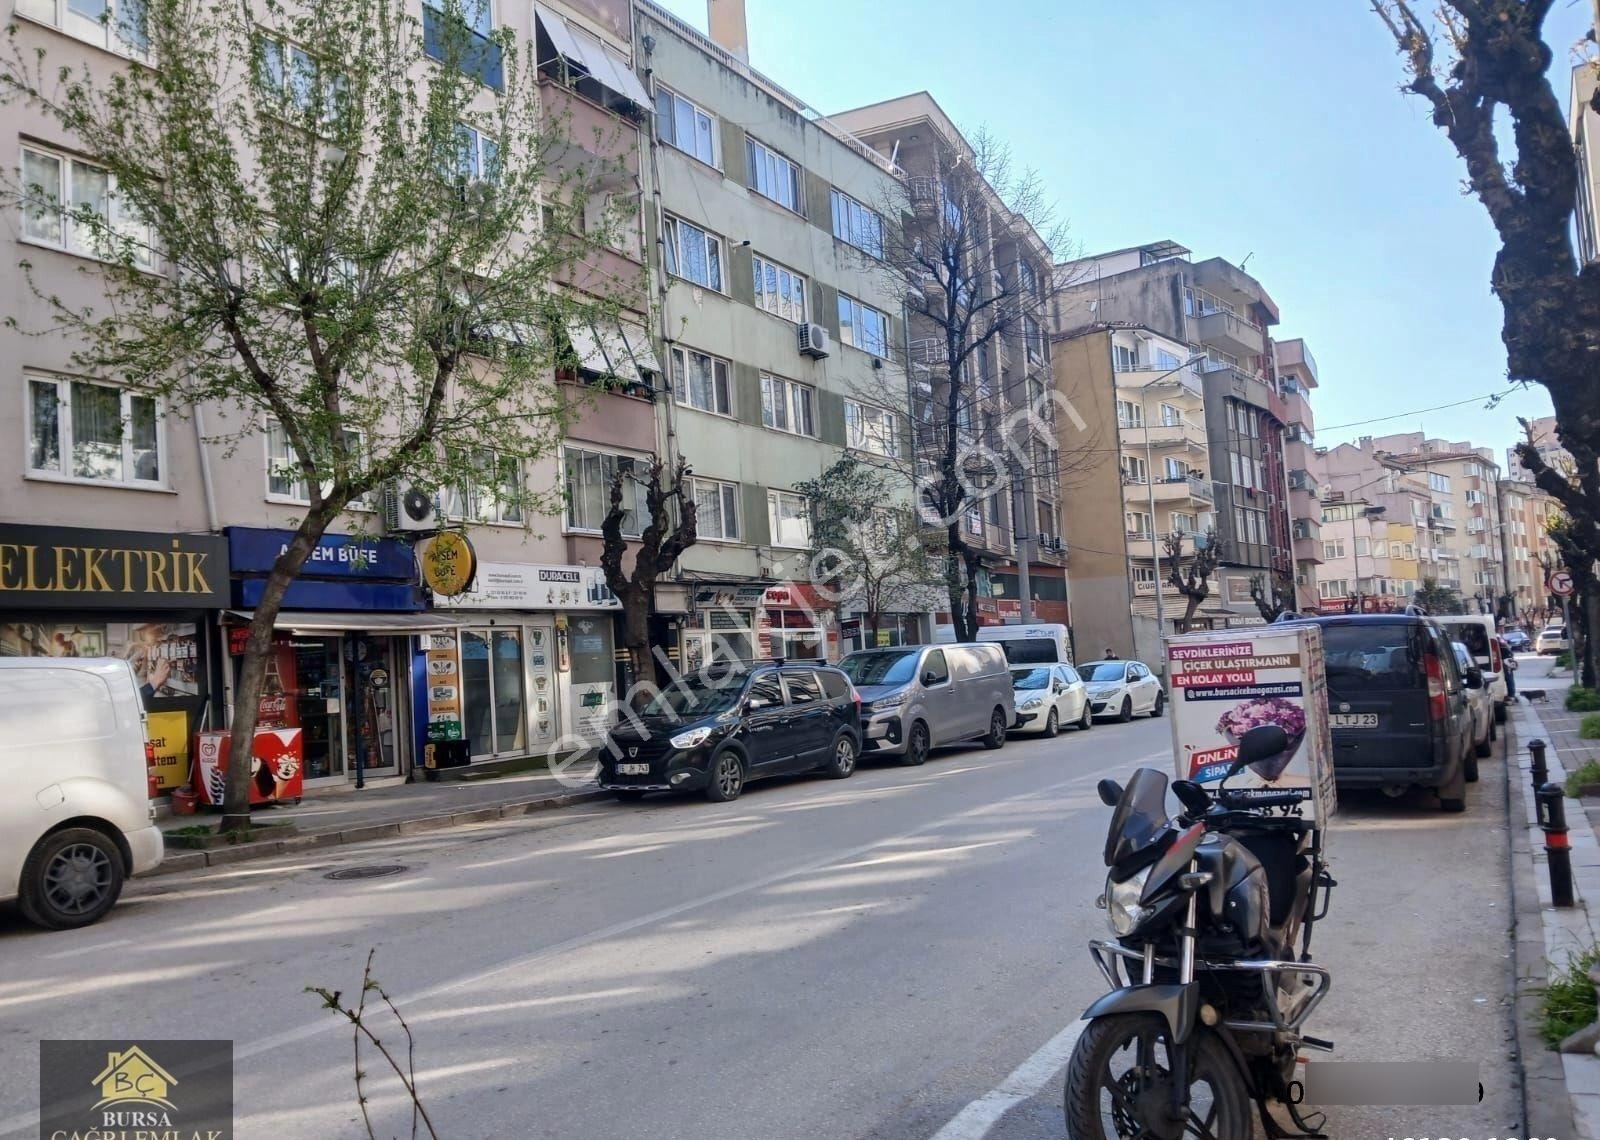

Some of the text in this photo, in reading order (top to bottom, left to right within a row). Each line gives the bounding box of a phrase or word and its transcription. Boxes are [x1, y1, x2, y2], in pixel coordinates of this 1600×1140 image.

[0, 538, 214, 594] ELEKTRİK
[540, 571, 579, 582] DURACELL
[1172, 645, 1252, 659] SEVDİKLERİNİZE
[1183, 656, 1291, 673] ÇİÇEK ULAŞTIRMANIN
[1177, 672, 1253, 685] EN KOLAY YOLU
[1195, 685, 1300, 697] www.bursacicekmagazasi.com
[1335, 714, 1377, 725] LTJ 23
[150, 736, 167, 748] sat
[1196, 747, 1240, 765] ONLİN
